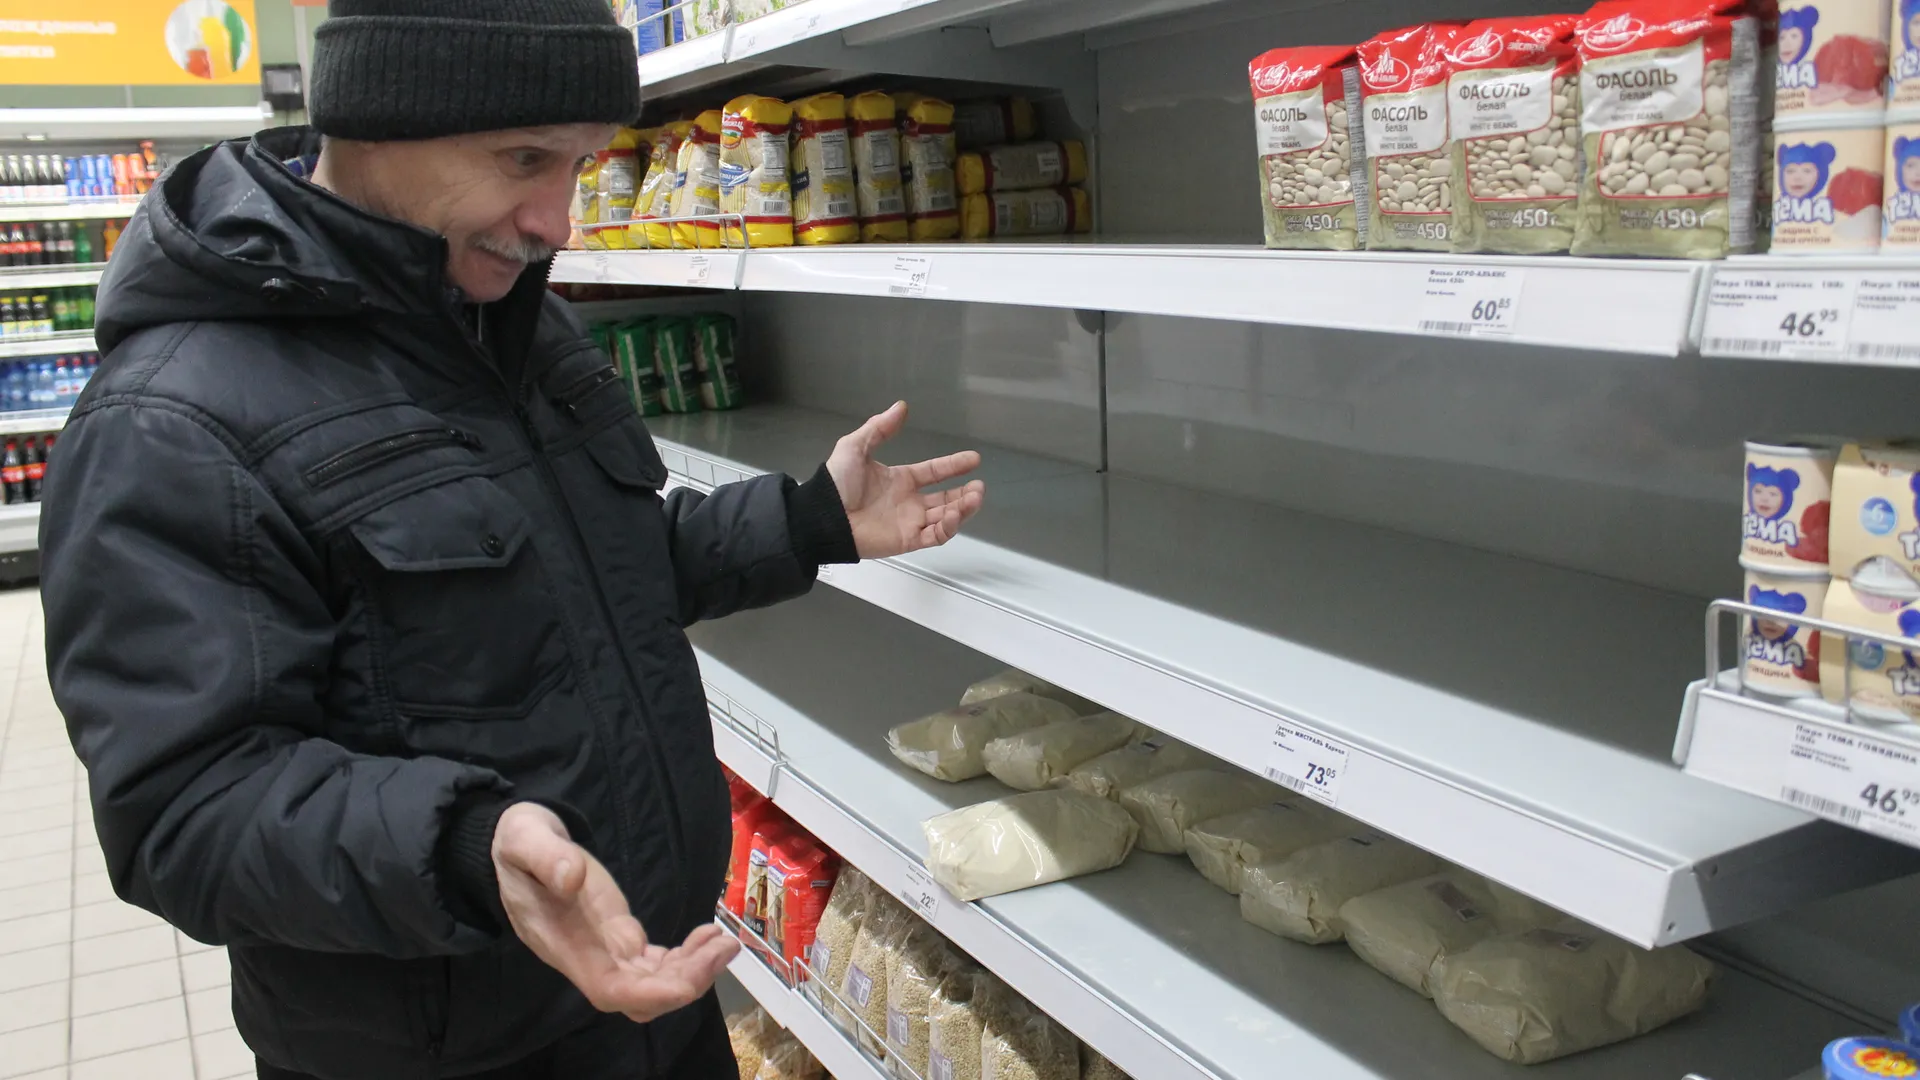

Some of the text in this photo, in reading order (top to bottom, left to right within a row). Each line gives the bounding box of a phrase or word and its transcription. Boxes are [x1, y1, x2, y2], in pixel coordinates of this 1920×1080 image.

[1595, 69, 1678, 89] ФАСОЛЬ
[1460, 83, 1530, 99] ФАСОЛЬ
[1372, 105, 1428, 121] ФАСОЛЬ
[1476, 101, 1506, 111] белая
[1261, 108, 1307, 122] ФАСОЛЬ
[1272, 125, 1290, 133] белая
[1385, 124, 1407, 132] белая
[1304, 214, 1332, 231] 450
[1512, 208, 1548, 228] 450
[1653, 208, 1697, 229] 450
[1417, 222, 1446, 240] 450
[1295, 731, 1324, 746] МИСТРАЛЬ
